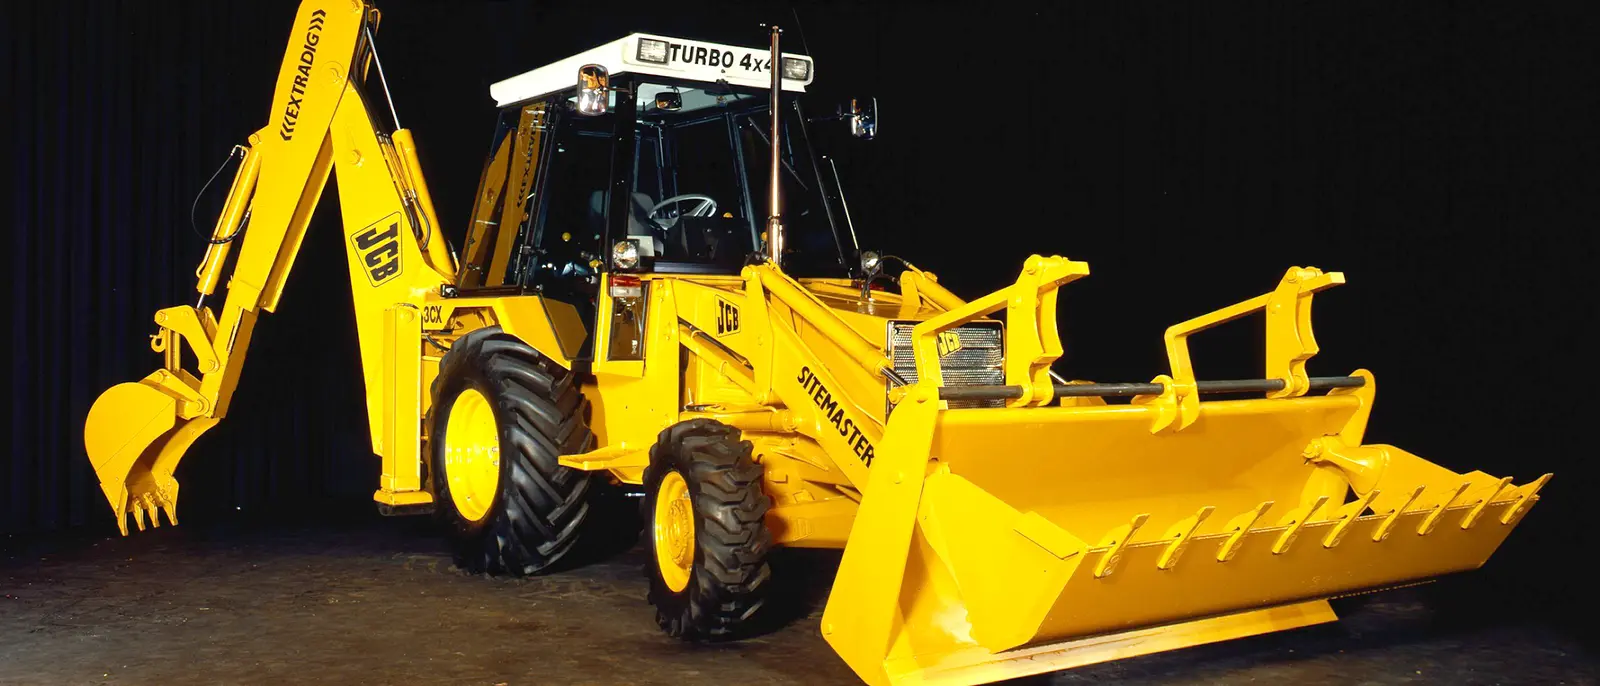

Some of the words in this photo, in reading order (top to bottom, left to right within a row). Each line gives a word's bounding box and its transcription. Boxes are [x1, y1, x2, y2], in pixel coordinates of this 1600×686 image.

[669, 43, 734, 69] TURBO
[285, 31, 320, 120] EXTRADIG
[355, 222, 399, 282] JCB
[423, 305, 443, 324] 3CX
[717, 299, 739, 335] JCB
[938, 331, 961, 356] JCB
[797, 365, 875, 469] SITEMASTER
